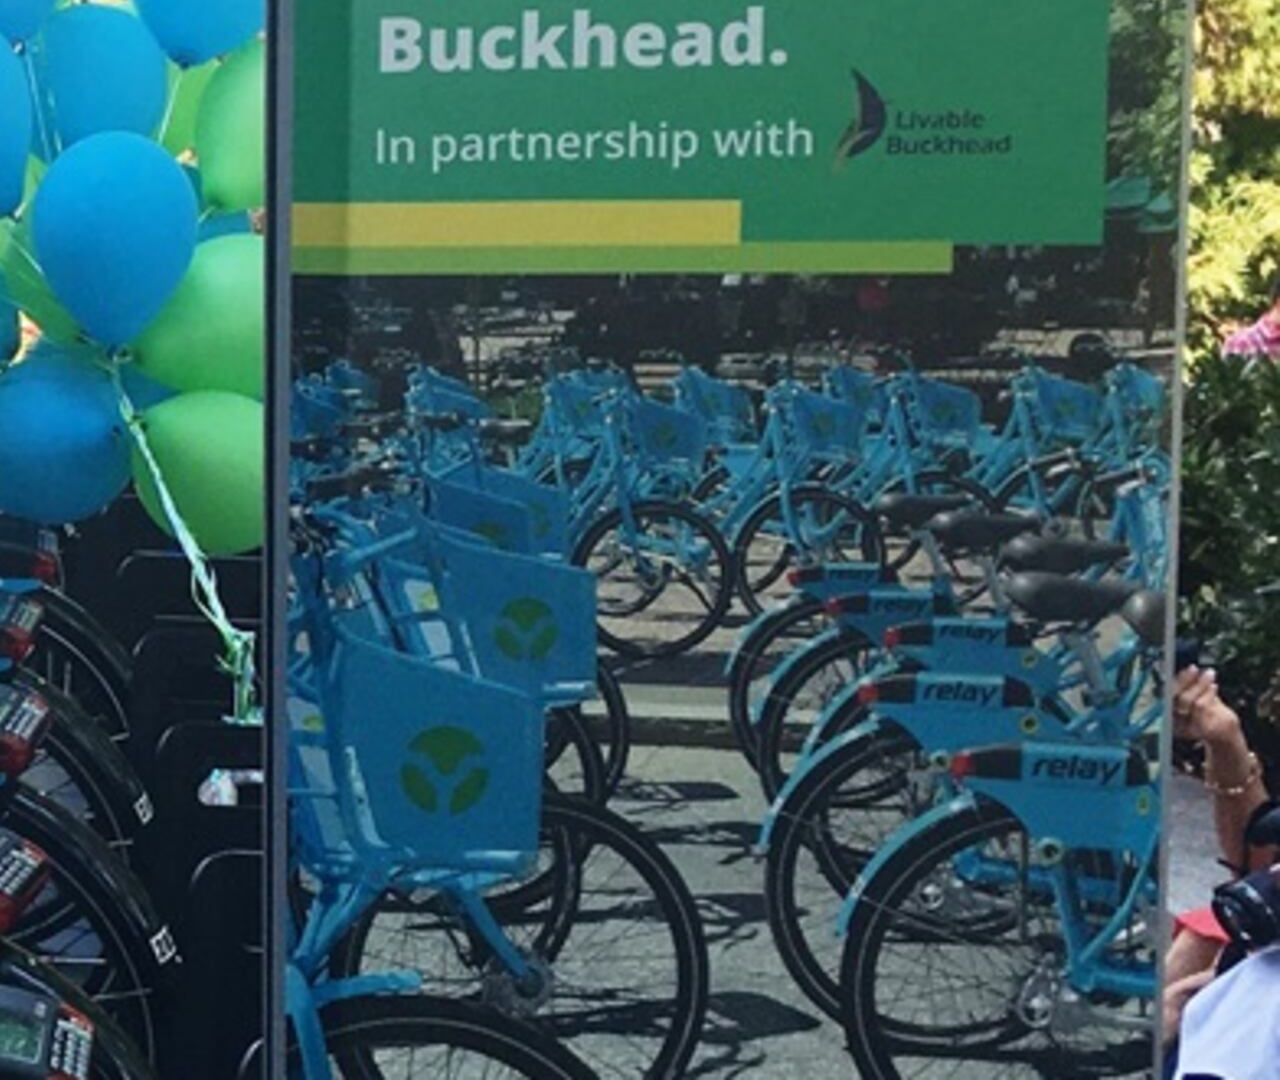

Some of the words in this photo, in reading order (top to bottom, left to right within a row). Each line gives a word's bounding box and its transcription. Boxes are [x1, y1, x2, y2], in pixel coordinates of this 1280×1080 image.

[379, 5, 788, 73] Buckhead.
[896, 110, 985, 129] Livable
[375, 128, 416, 163] In
[432, 122, 699, 173] partnership
[713, 120, 814, 157] with
[886, 134, 1013, 155] Buckhead
[923, 680, 995, 705] relay
[1032, 753, 1122, 785] relay
